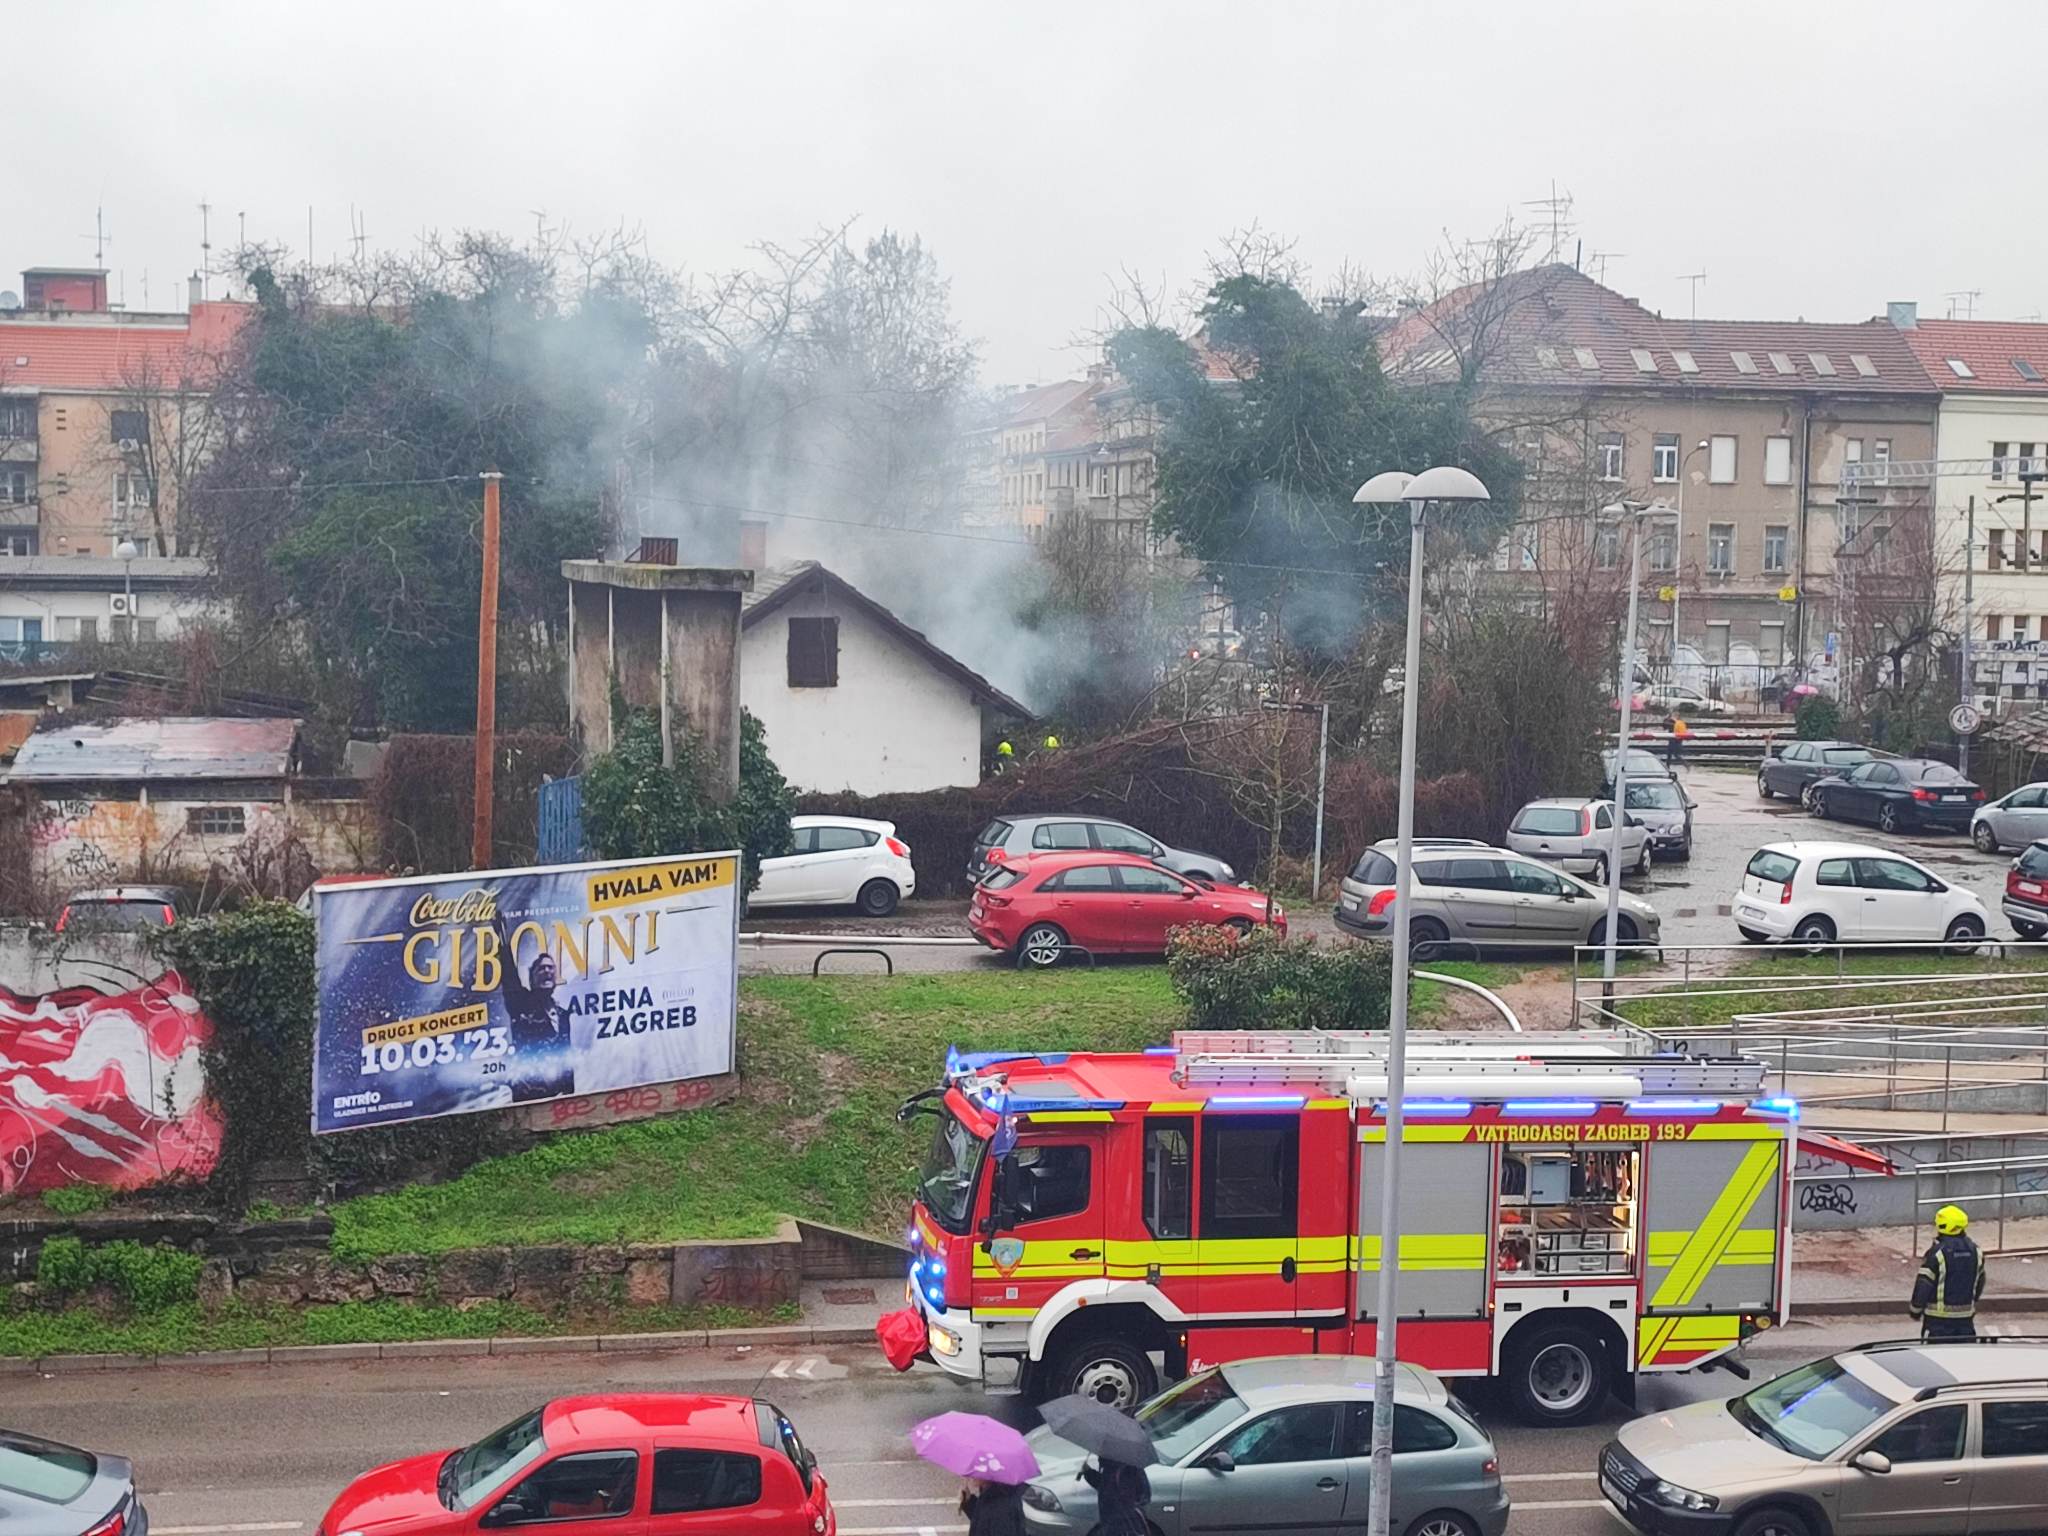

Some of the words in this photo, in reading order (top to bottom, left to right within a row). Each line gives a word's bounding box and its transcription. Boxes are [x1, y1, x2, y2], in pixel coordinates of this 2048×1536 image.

[593, 873, 663, 902] HVALA
[668, 862, 718, 888] VAM!
[403, 909, 660, 993] GIBONNI
[567, 986, 654, 1017] ARENA
[367, 1023, 415, 1044] DRUGI
[419, 1009, 485, 1033] KONCERT
[597, 1005, 697, 1040] ZAGREB
[482, 1062, 506, 1075] 20h
[1474, 1123, 1580, 1142] VATROGASCI
[1584, 1123, 1651, 1141] ZAGREB
[1656, 1122, 1686, 1141] 193
